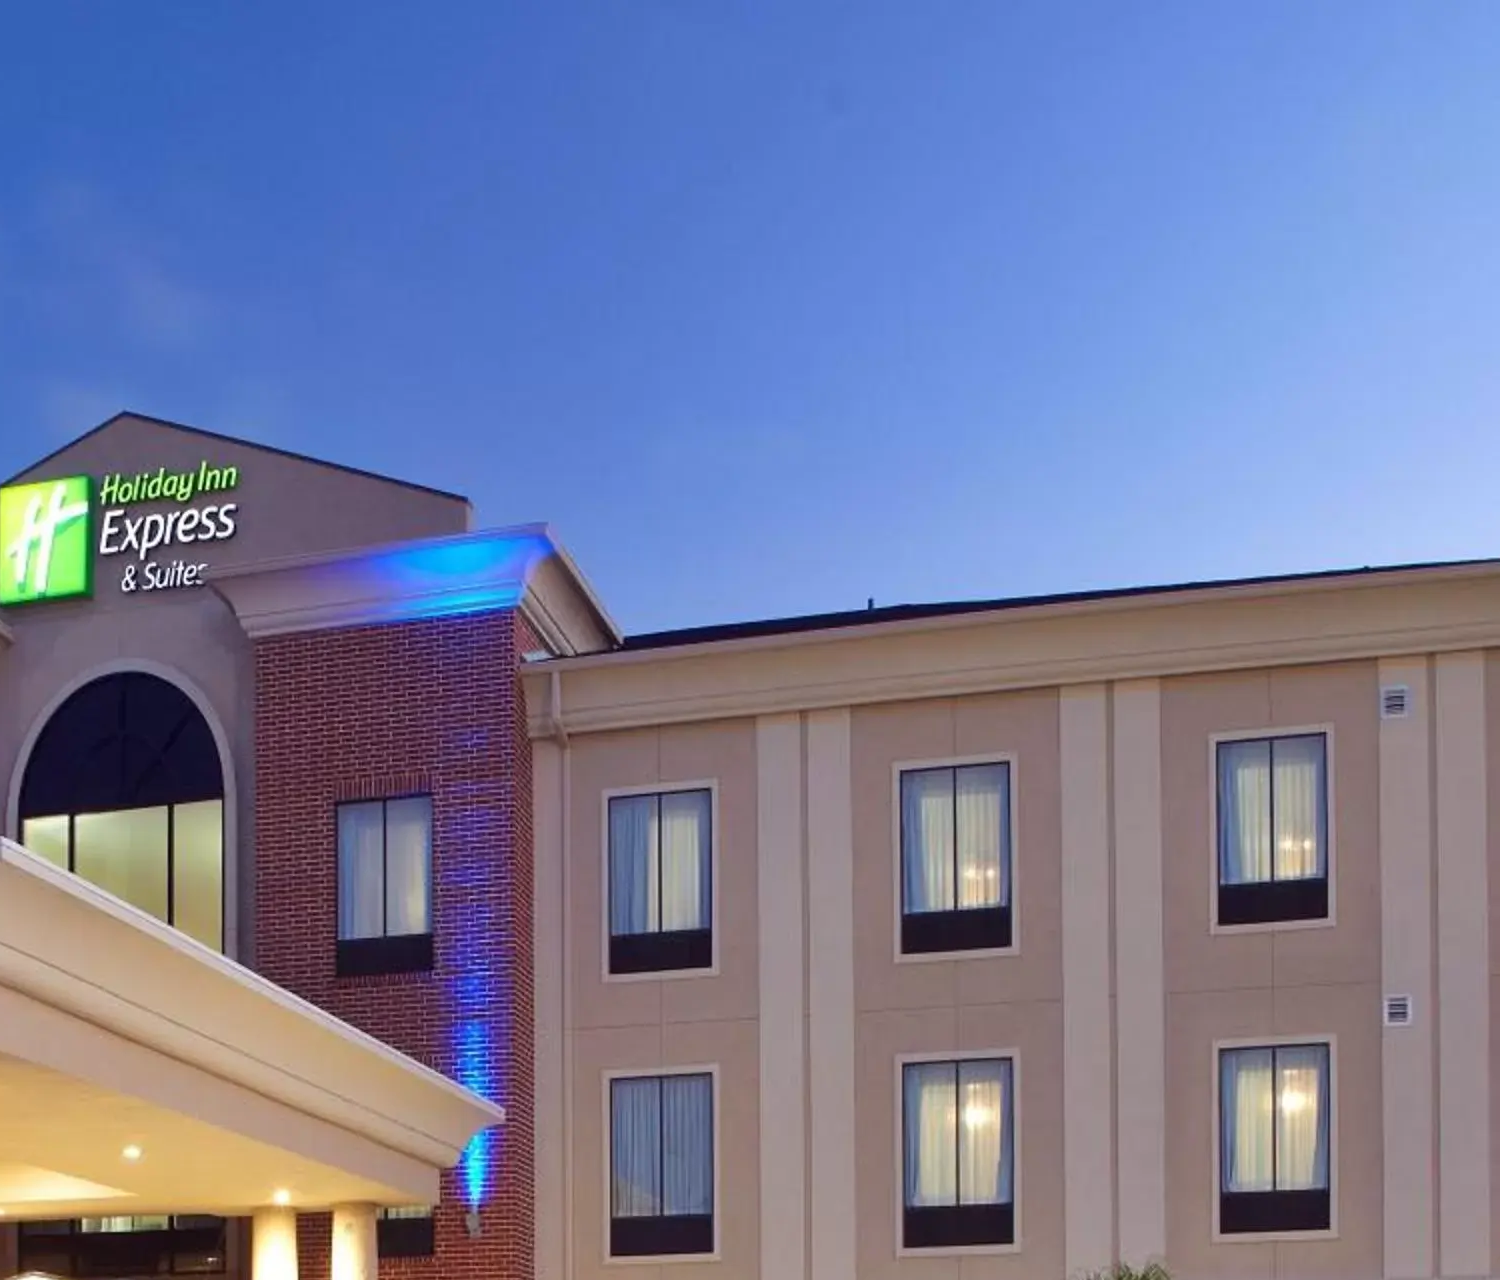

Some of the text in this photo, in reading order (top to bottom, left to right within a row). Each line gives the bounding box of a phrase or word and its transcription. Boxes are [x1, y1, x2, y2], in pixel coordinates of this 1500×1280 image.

[100, 460, 237, 505] Holiday Inn
[100, 503, 237, 560] Express
[120, 565, 137, 592] &
